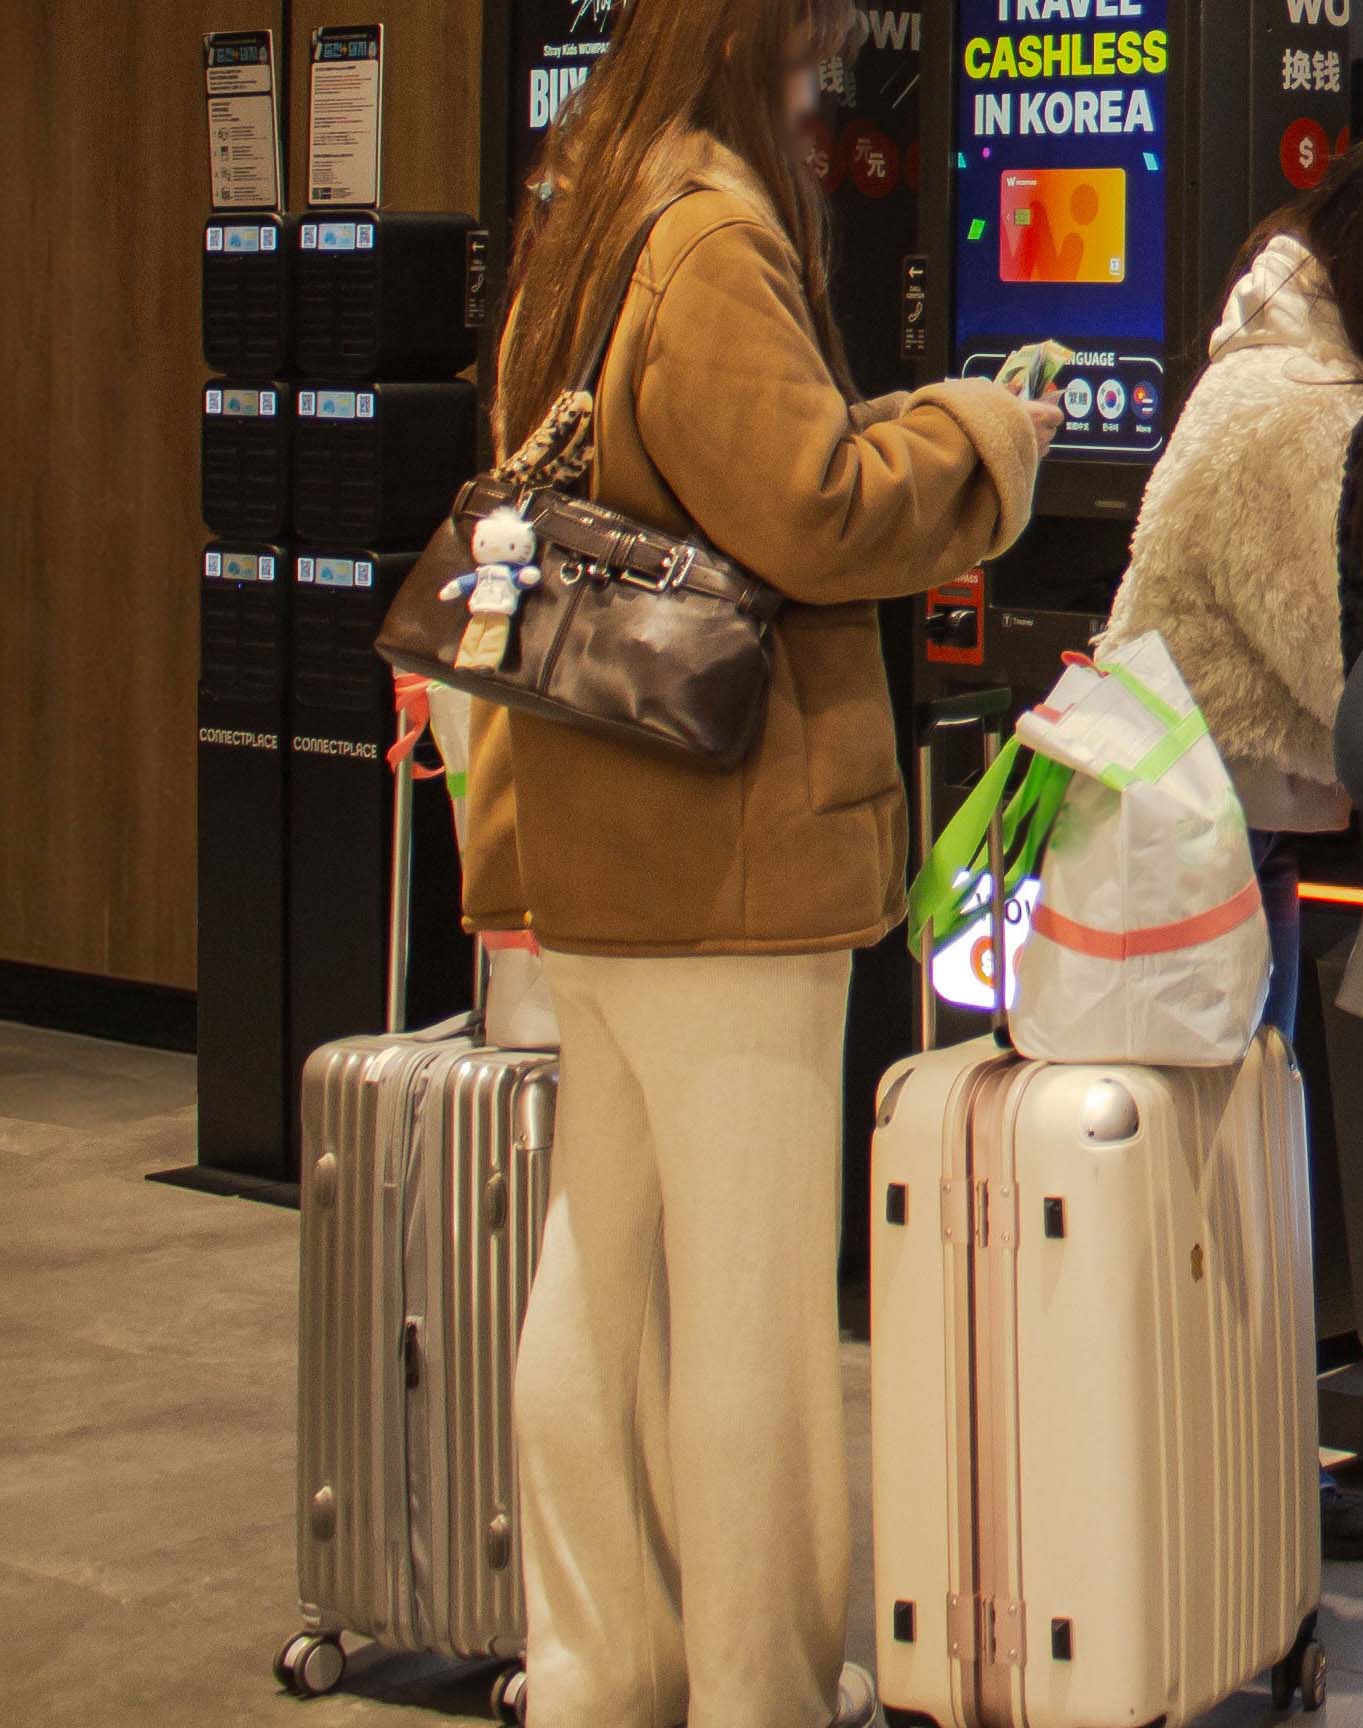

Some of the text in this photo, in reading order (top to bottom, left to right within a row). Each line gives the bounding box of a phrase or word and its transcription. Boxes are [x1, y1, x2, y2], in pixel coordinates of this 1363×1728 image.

[964, 30, 1168, 80] CASHLESS
[974, 89, 1155, 136] IN KOREA
[1064, 352, 1115, 367] NGUAGE
